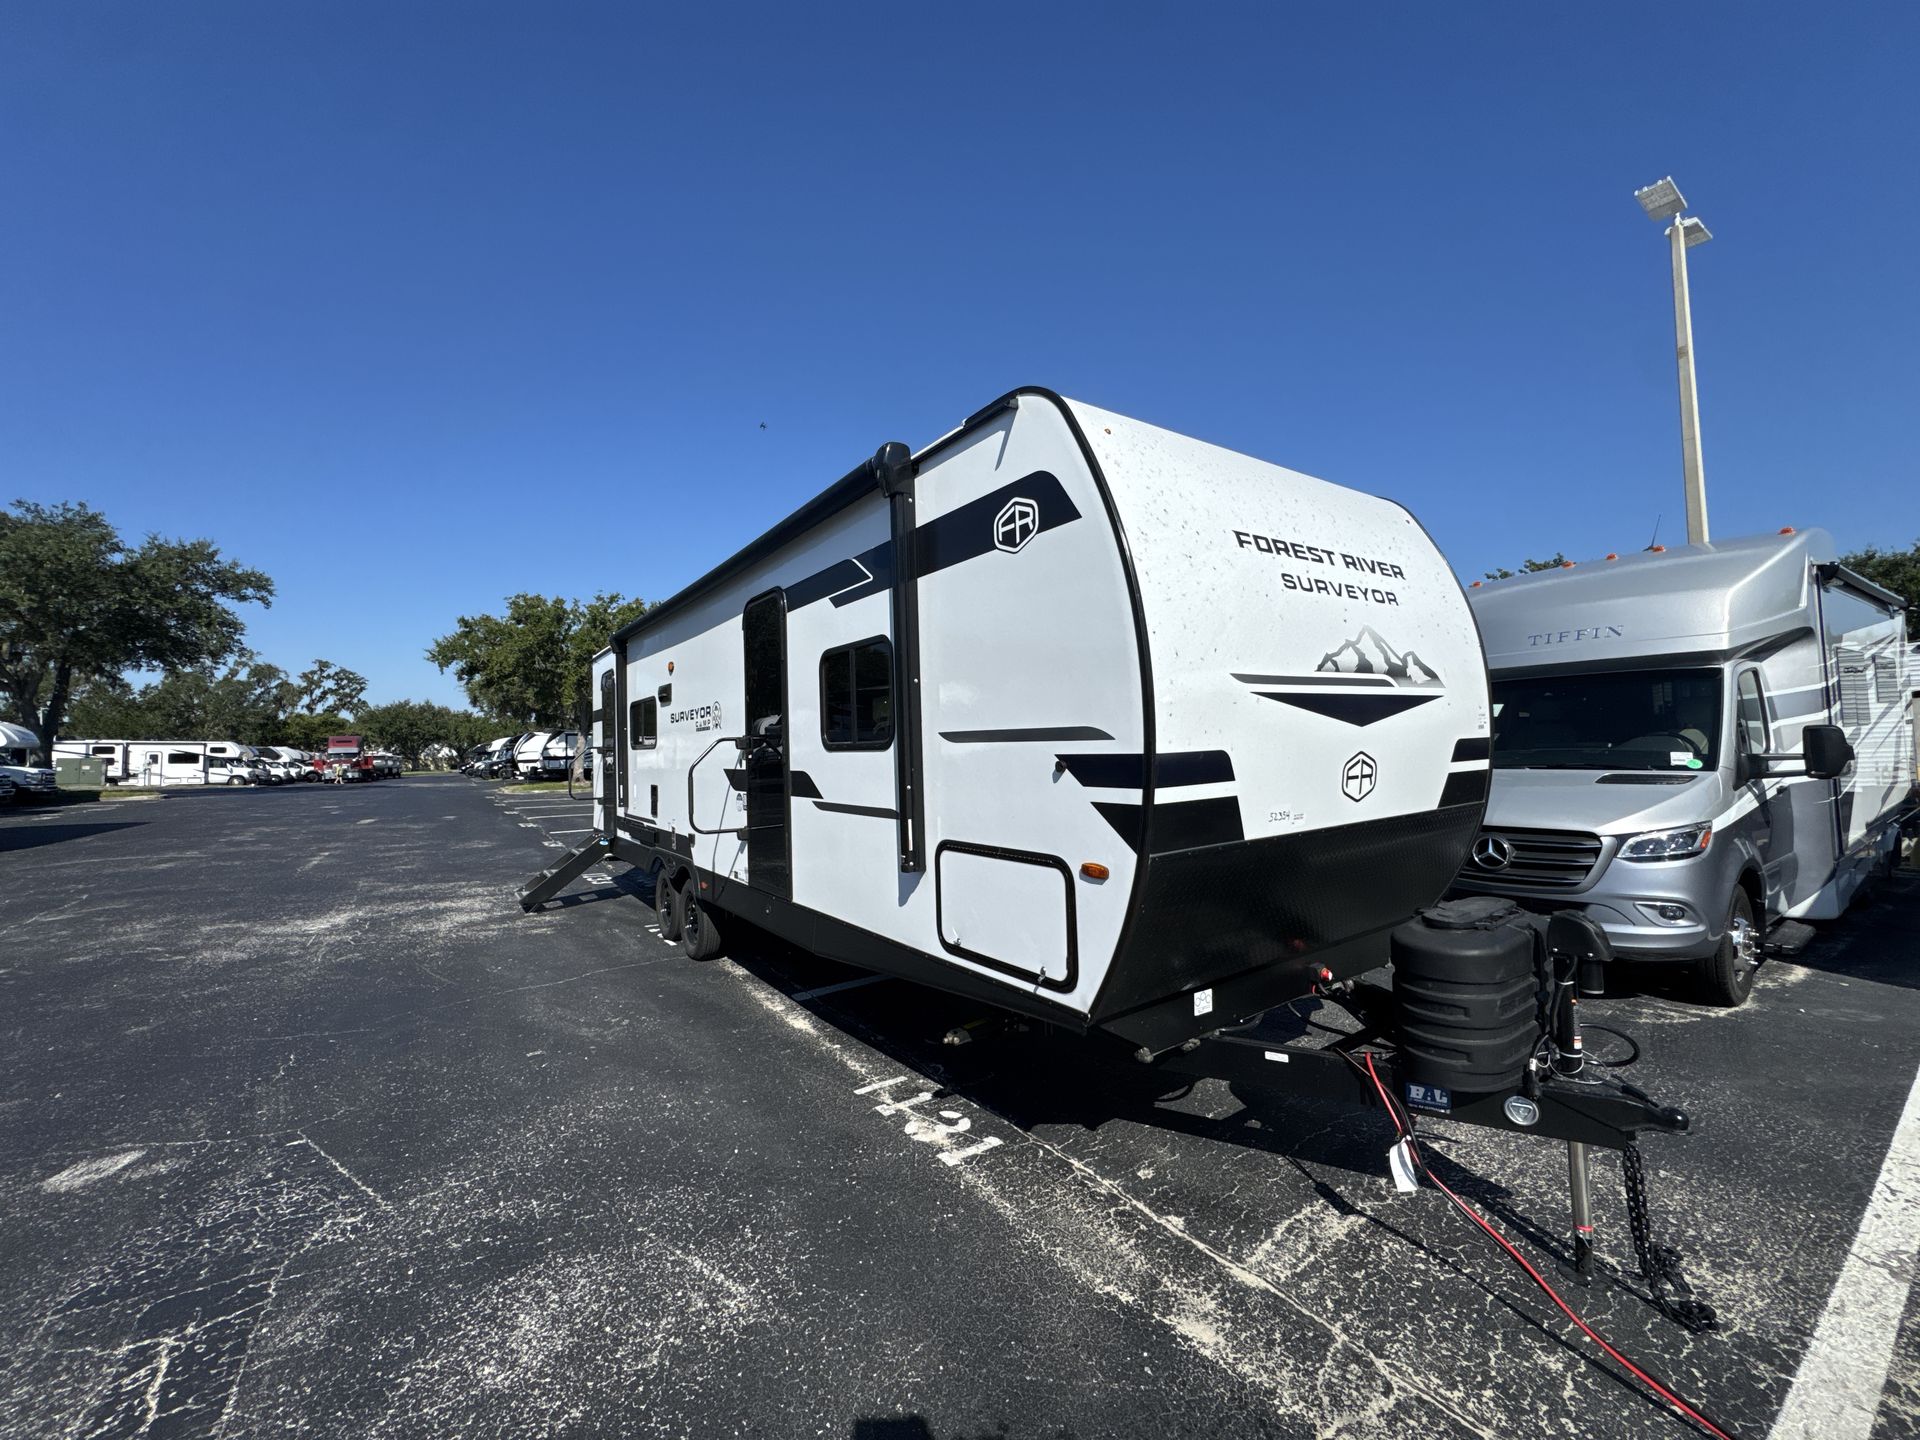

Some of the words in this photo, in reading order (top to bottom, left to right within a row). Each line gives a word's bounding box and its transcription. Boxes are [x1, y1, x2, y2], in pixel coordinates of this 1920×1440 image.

[1232, 530, 1335, 566] FOREST
[1339, 552, 1405, 580] RIVER
[1281, 573, 1399, 606] SURVEYOR
[1528, 625, 1624, 646] TIFFIN
[670, 705, 712, 724] SURVEYOR
